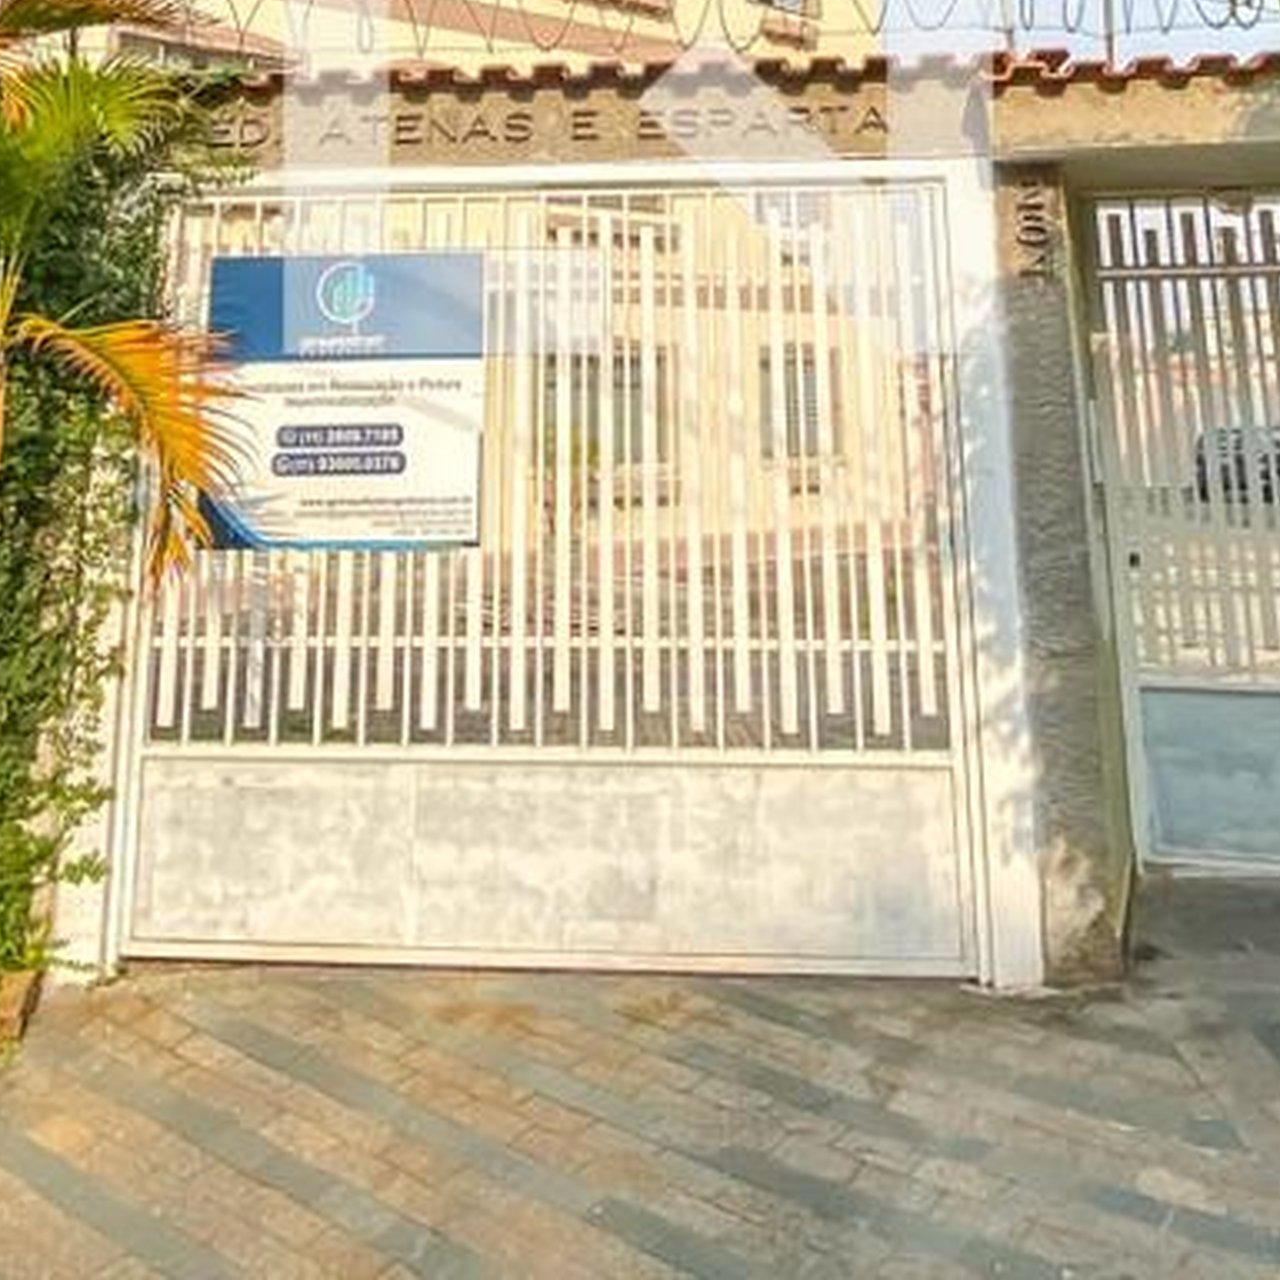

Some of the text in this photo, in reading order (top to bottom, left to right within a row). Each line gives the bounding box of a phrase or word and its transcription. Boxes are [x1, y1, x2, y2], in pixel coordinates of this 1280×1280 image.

[319, 111, 535, 147] ATENAS
[571, 109, 600, 141] E
[636, 105, 890, 142] ESPARTA
